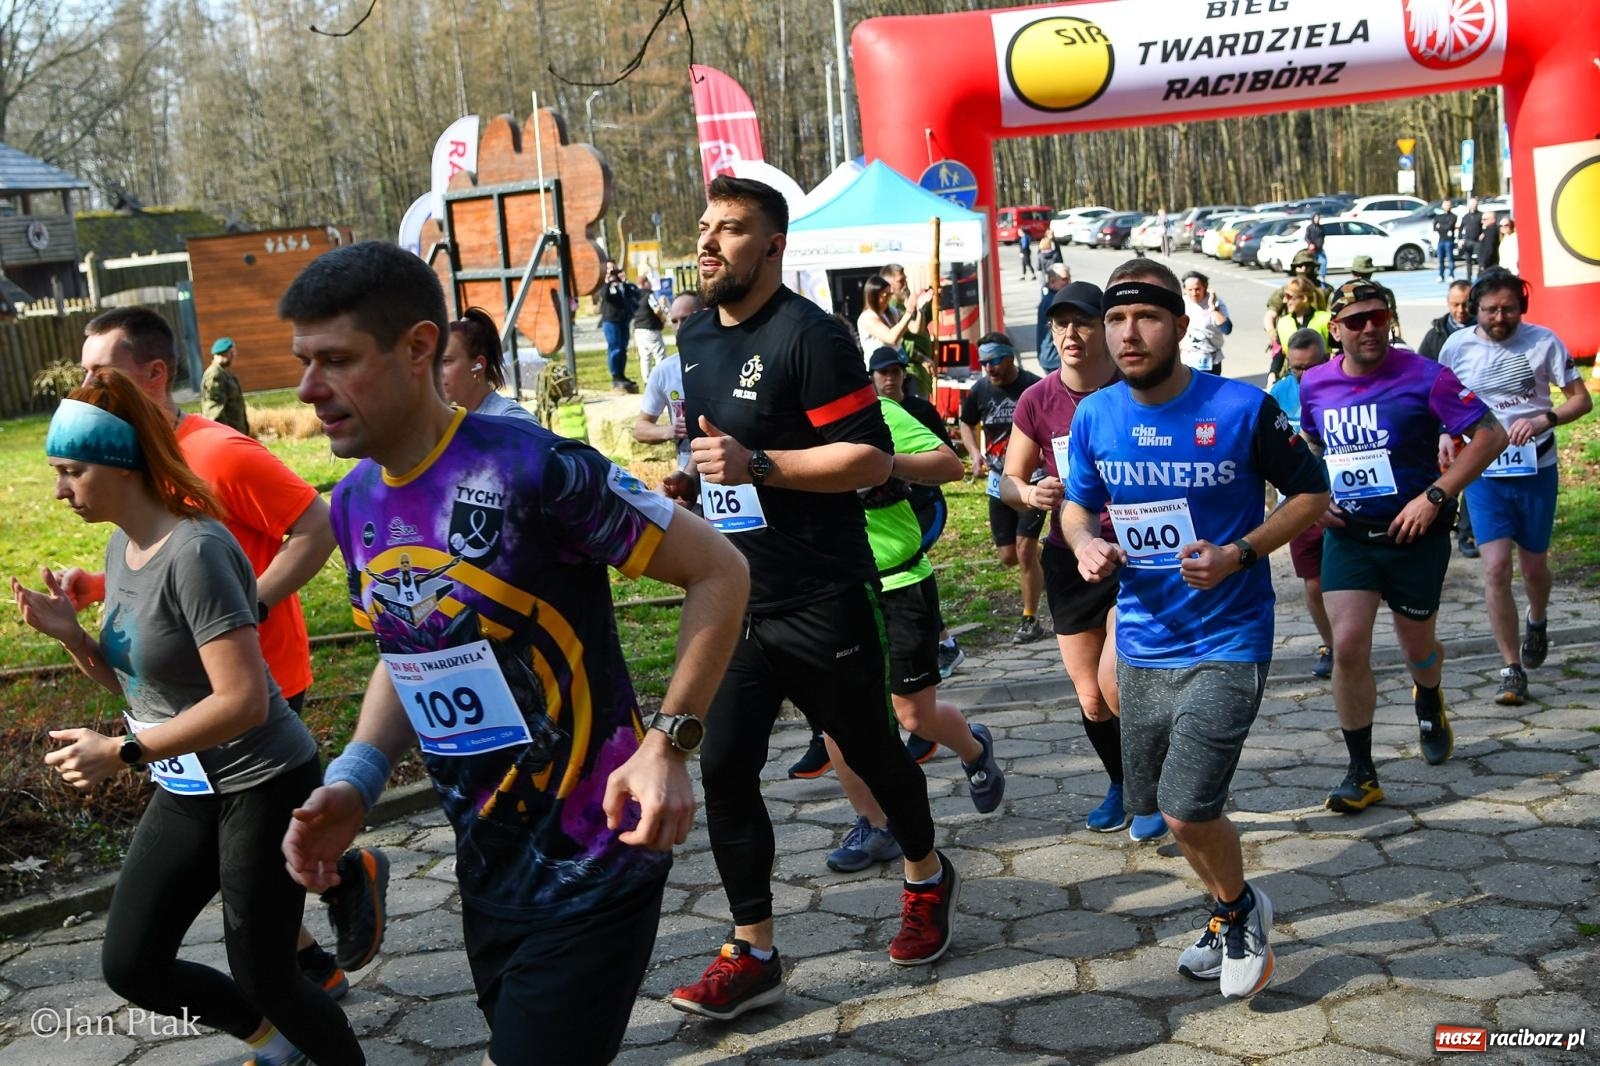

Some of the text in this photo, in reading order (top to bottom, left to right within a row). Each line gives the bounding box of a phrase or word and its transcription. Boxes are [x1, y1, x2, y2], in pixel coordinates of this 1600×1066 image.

[1206, 0, 1289, 19] BIEG
[1054, 25, 1109, 45] SIR
[1138, 19, 1370, 65] TWARDZIELA
[1163, 61, 1347, 101] RACIBÓRZ
[732, 388, 757, 401] POLSKA
[1095, 460, 1237, 488] RUNNERS
[1341, 467, 1378, 487] 091
[456, 486, 508, 507] TYCHY
[708, 489, 741, 514] 126
[1124, 508, 1138, 516] BIEG
[1139, 503, 1182, 515] TWARDZIELA
[1127, 524, 1180, 550] 040
[420, 651, 484, 672] TWARDZIELA
[414, 686, 485, 729] 109
